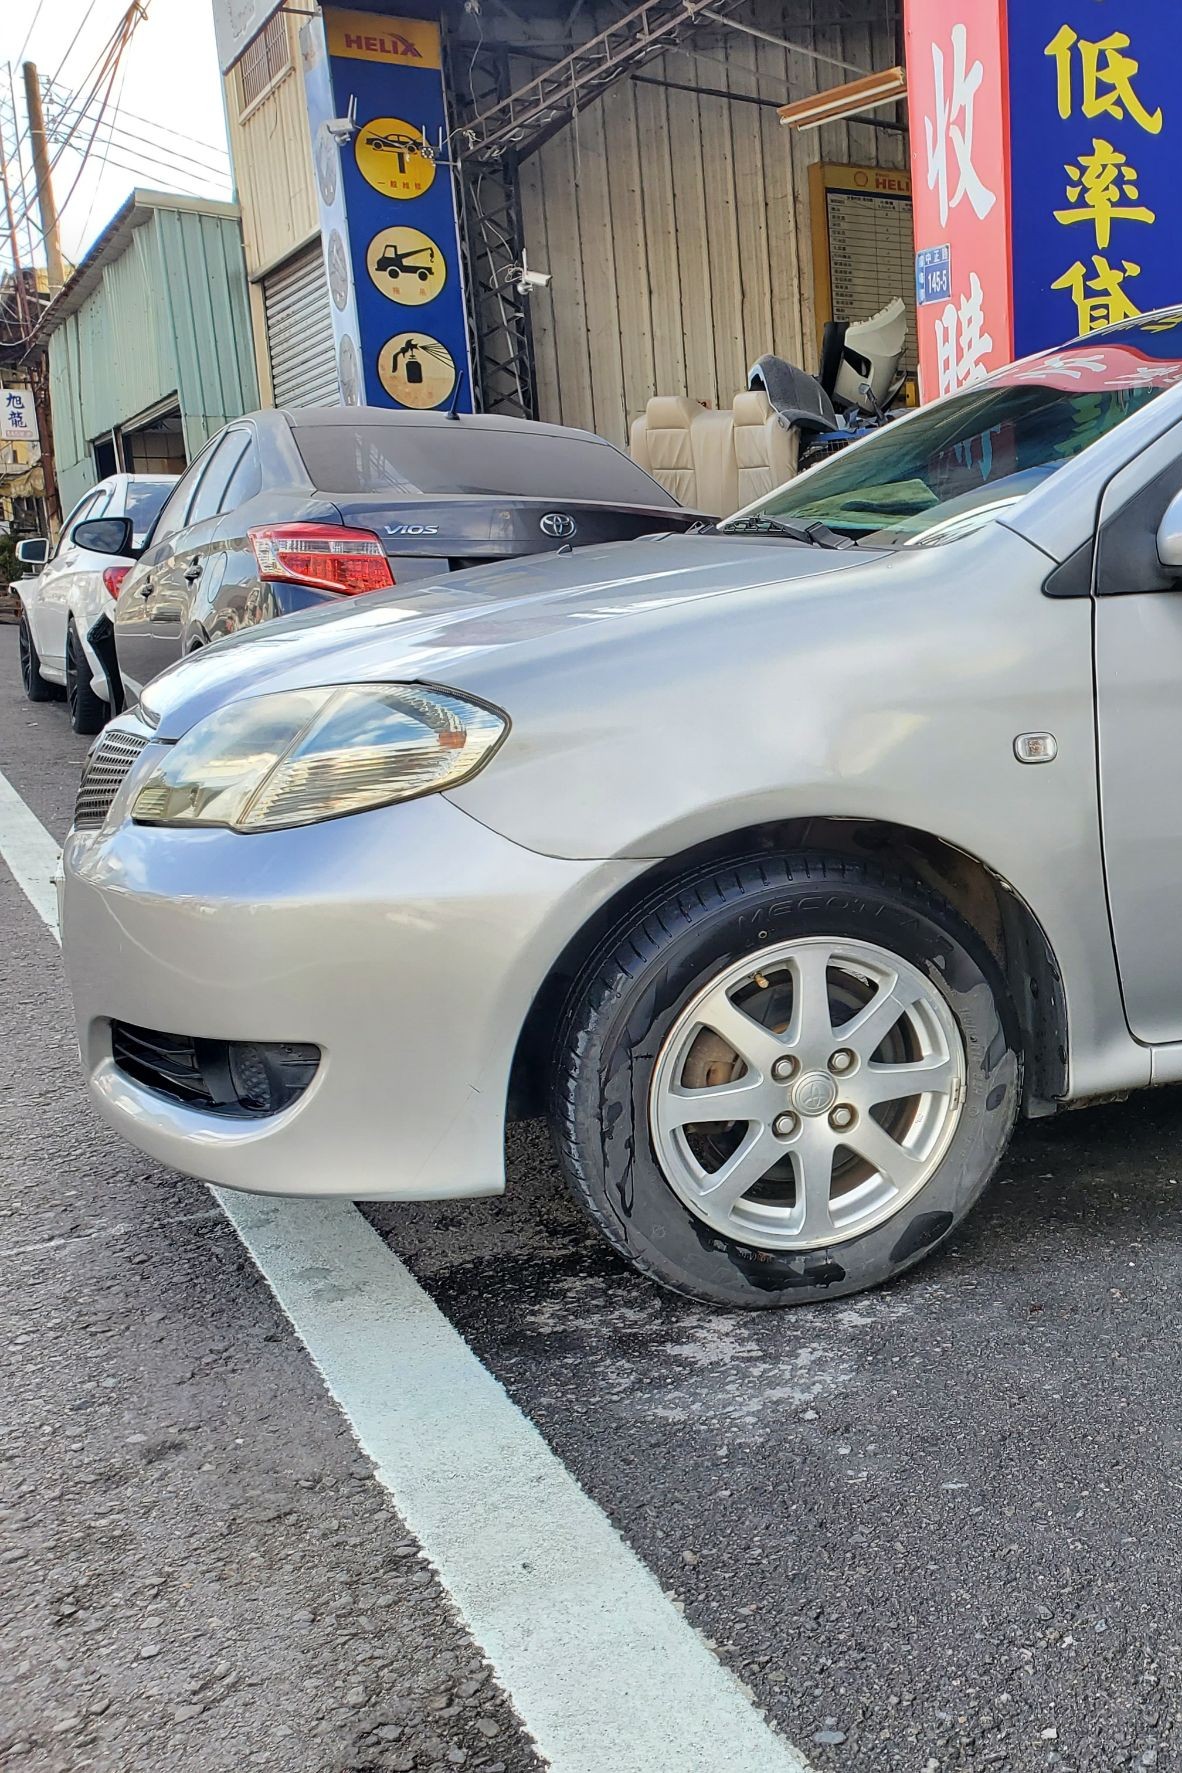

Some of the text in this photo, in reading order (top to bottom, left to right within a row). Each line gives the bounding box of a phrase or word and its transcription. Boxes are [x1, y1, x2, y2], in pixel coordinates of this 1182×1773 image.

[344, 32, 423, 58] HELIX
[875, 177, 911, 191] HELI
[1044, 24, 1163, 336] 低率貸
[928, 270, 947, 294] 145-5
[5, 392, 28, 428] 旭龍
[383, 525, 439, 536] VIOS
